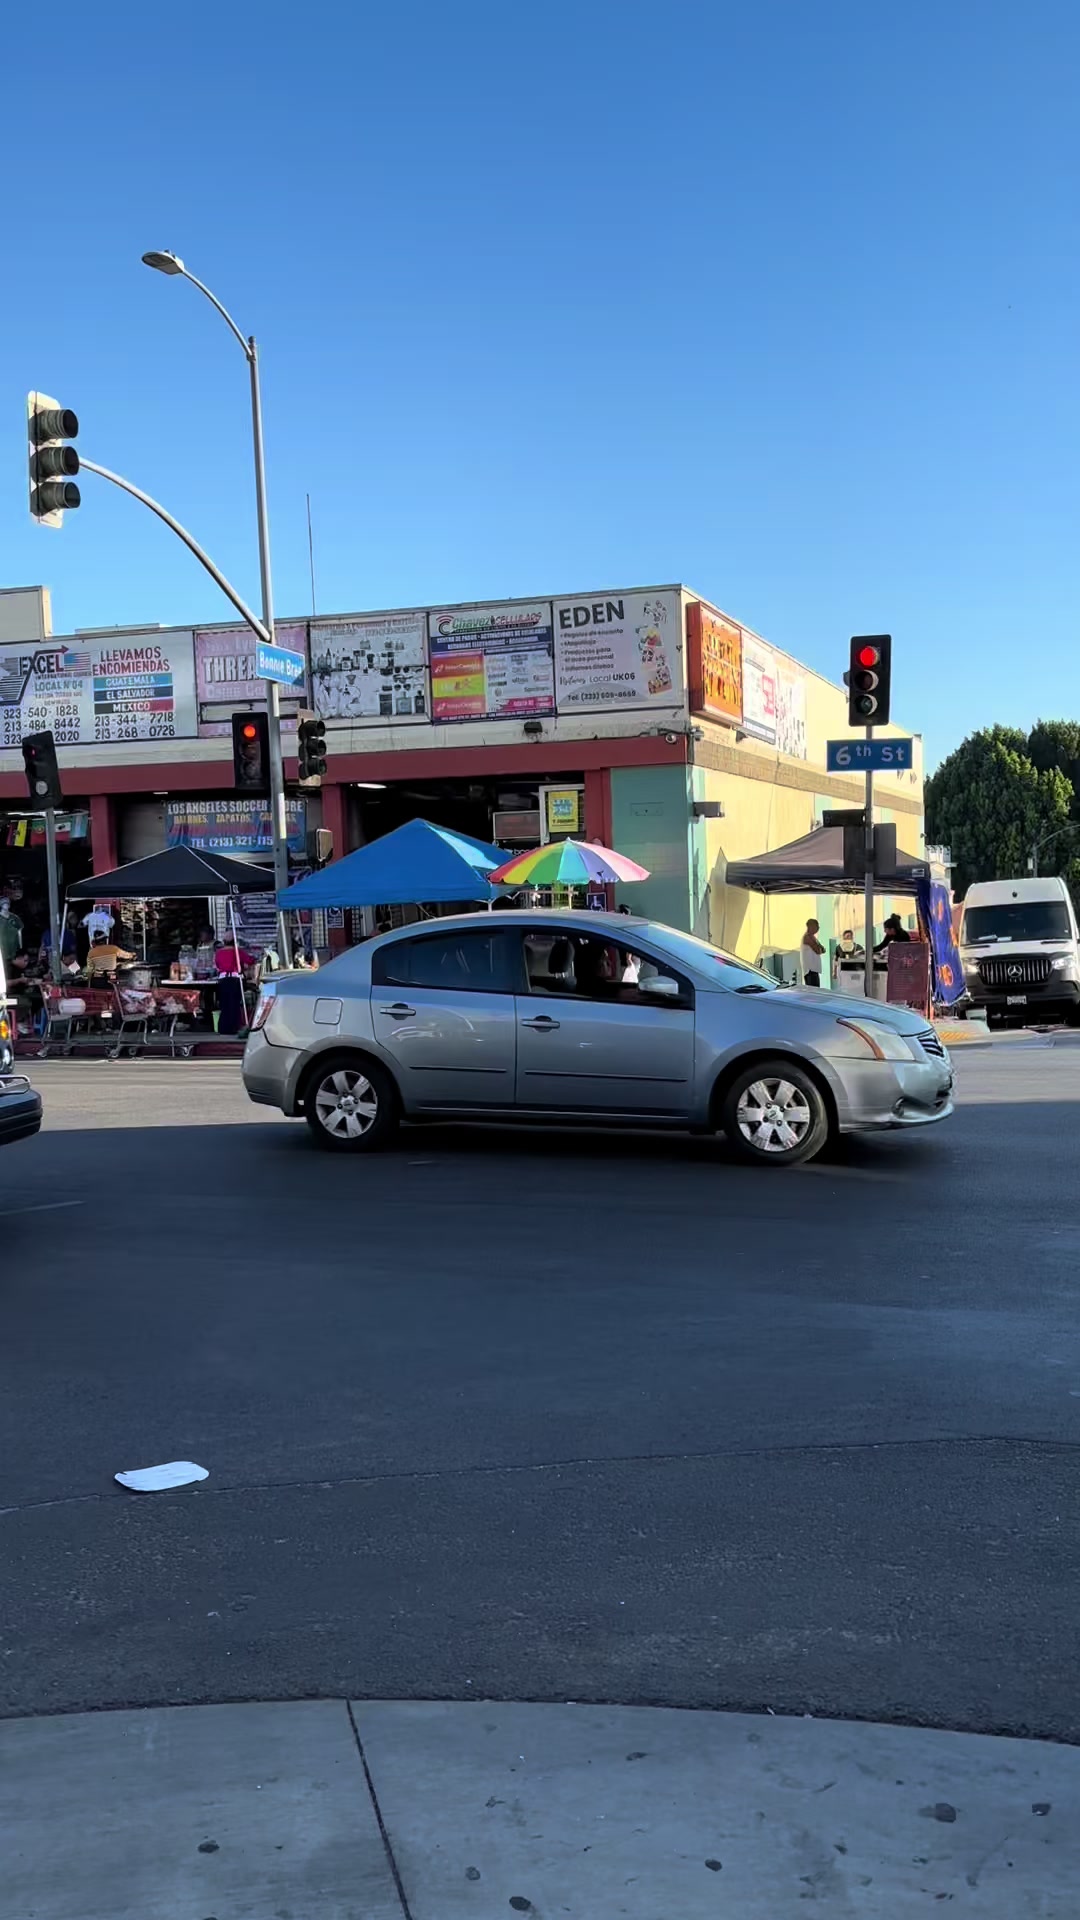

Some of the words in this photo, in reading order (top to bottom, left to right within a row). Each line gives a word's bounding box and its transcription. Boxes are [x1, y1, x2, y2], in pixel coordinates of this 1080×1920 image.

[559, 600, 624, 629] EDEN
[100, 646, 162, 662] LLEVAMOS
[20, 654, 64, 676] EXCEL
[92, 659, 170, 676] ENCOMIENDAS
[260, 651, 284, 674] Bonnie
[105, 675, 156, 687] GUATEMALA
[612, 672, 636, 681] UK06
[35, 680, 62, 691] LOCAL
[106, 691, 116, 700] EL
[117, 688, 155, 699] SALVADOR
[113, 701, 151, 712] MEXICO
[836, 745, 872, 765] 6th
[881, 746, 905, 762] St
[168, 803, 185, 815] LOS
[186, 800, 228, 814] ANGELES
[230, 800, 267, 812] SOCCER
[209, 838, 233, 847] (213)
[235, 836, 275, 846] 321-115
